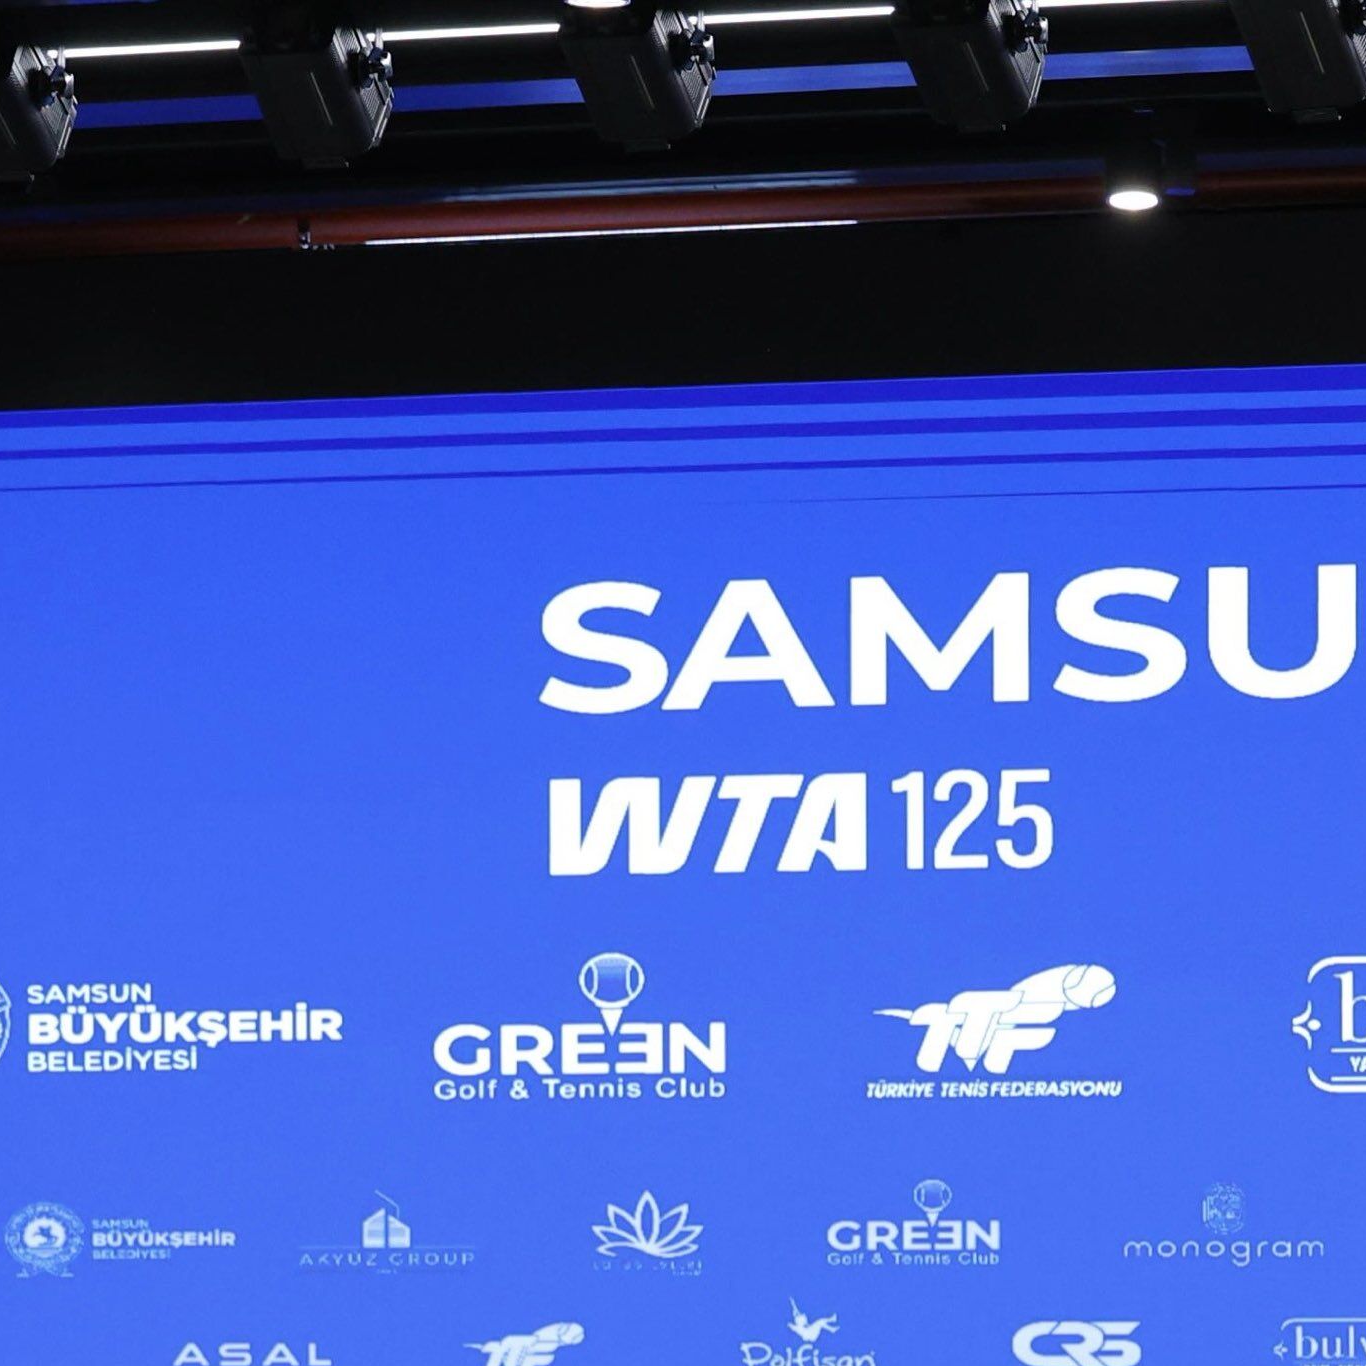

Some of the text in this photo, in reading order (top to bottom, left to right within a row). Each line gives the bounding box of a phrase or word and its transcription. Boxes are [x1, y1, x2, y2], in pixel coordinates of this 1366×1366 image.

[550, 769, 1053, 875] WTA 125
[27, 984, 151, 1005] SAMSUN
[28, 1002, 343, 1049] BÜYÜKŞEHİR
[27, 1046, 197, 1073] BELEDİYESİ
[434, 1022, 726, 1075] GREEN
[434, 1075, 726, 1100] Golf & Tennis Club
[867, 1079, 1122, 1098] TÜRKİYE TENİS FEDERASYONU
[92, 1219, 148, 1229] SAMSUN
[828, 1219, 1000, 1250] GREEN
[93, 1230, 235, 1248] BÜYÜKŞEHİR
[389, 1253, 474, 1266] GROUP
[827, 1250, 999, 1265] Golf & Tennis Club
[1124, 1241, 1323, 1267] monogram
[174, 1343, 331, 1366] ASAL
